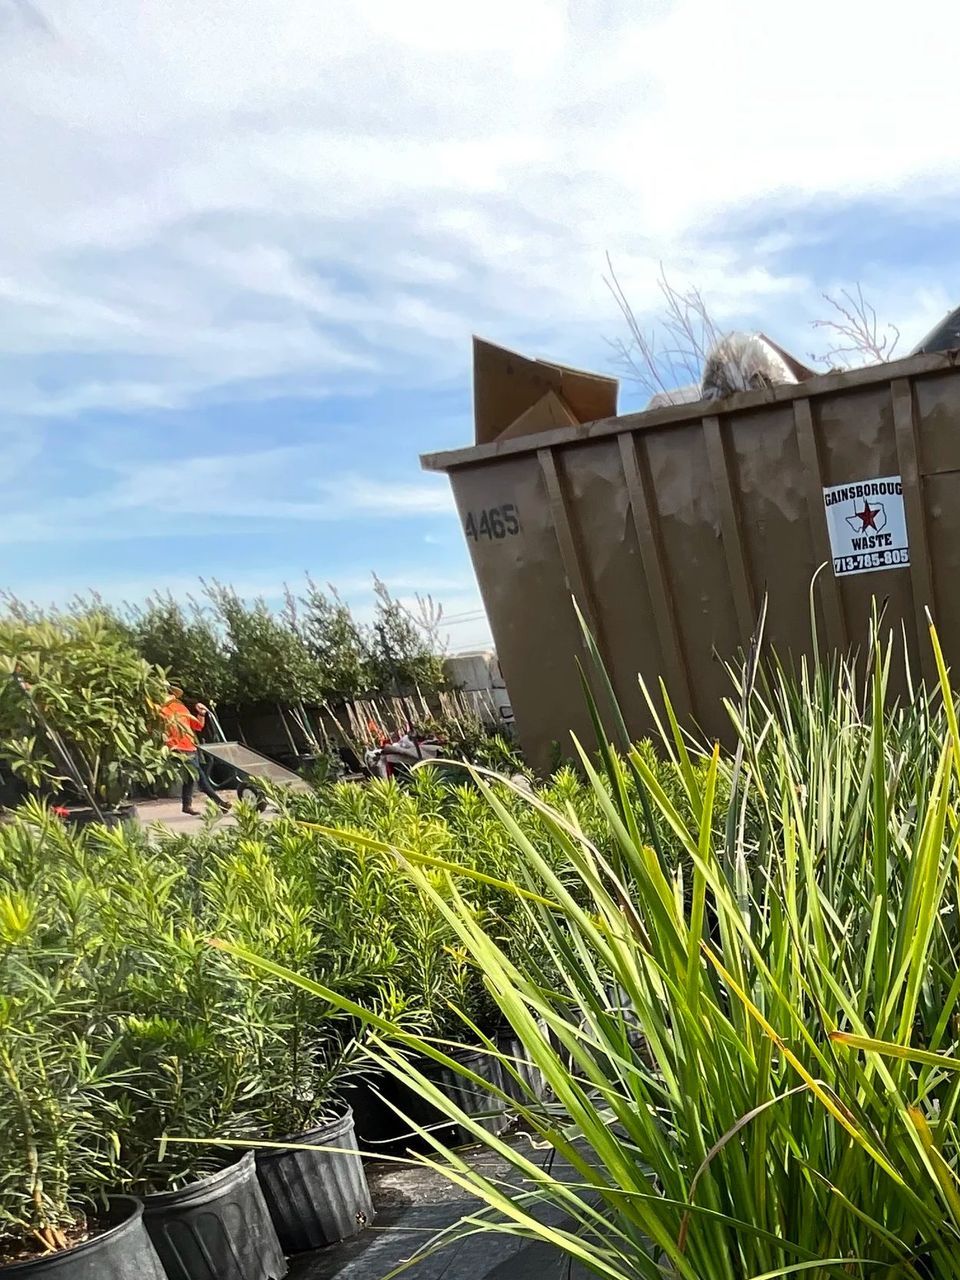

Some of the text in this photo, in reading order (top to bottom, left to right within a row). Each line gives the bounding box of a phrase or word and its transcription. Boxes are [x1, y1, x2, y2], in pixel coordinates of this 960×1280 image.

[825, 482, 903, 506] GAINSBOROUG
[852, 533, 892, 551] WASTE
[834, 550, 909, 572] 713-785-805
